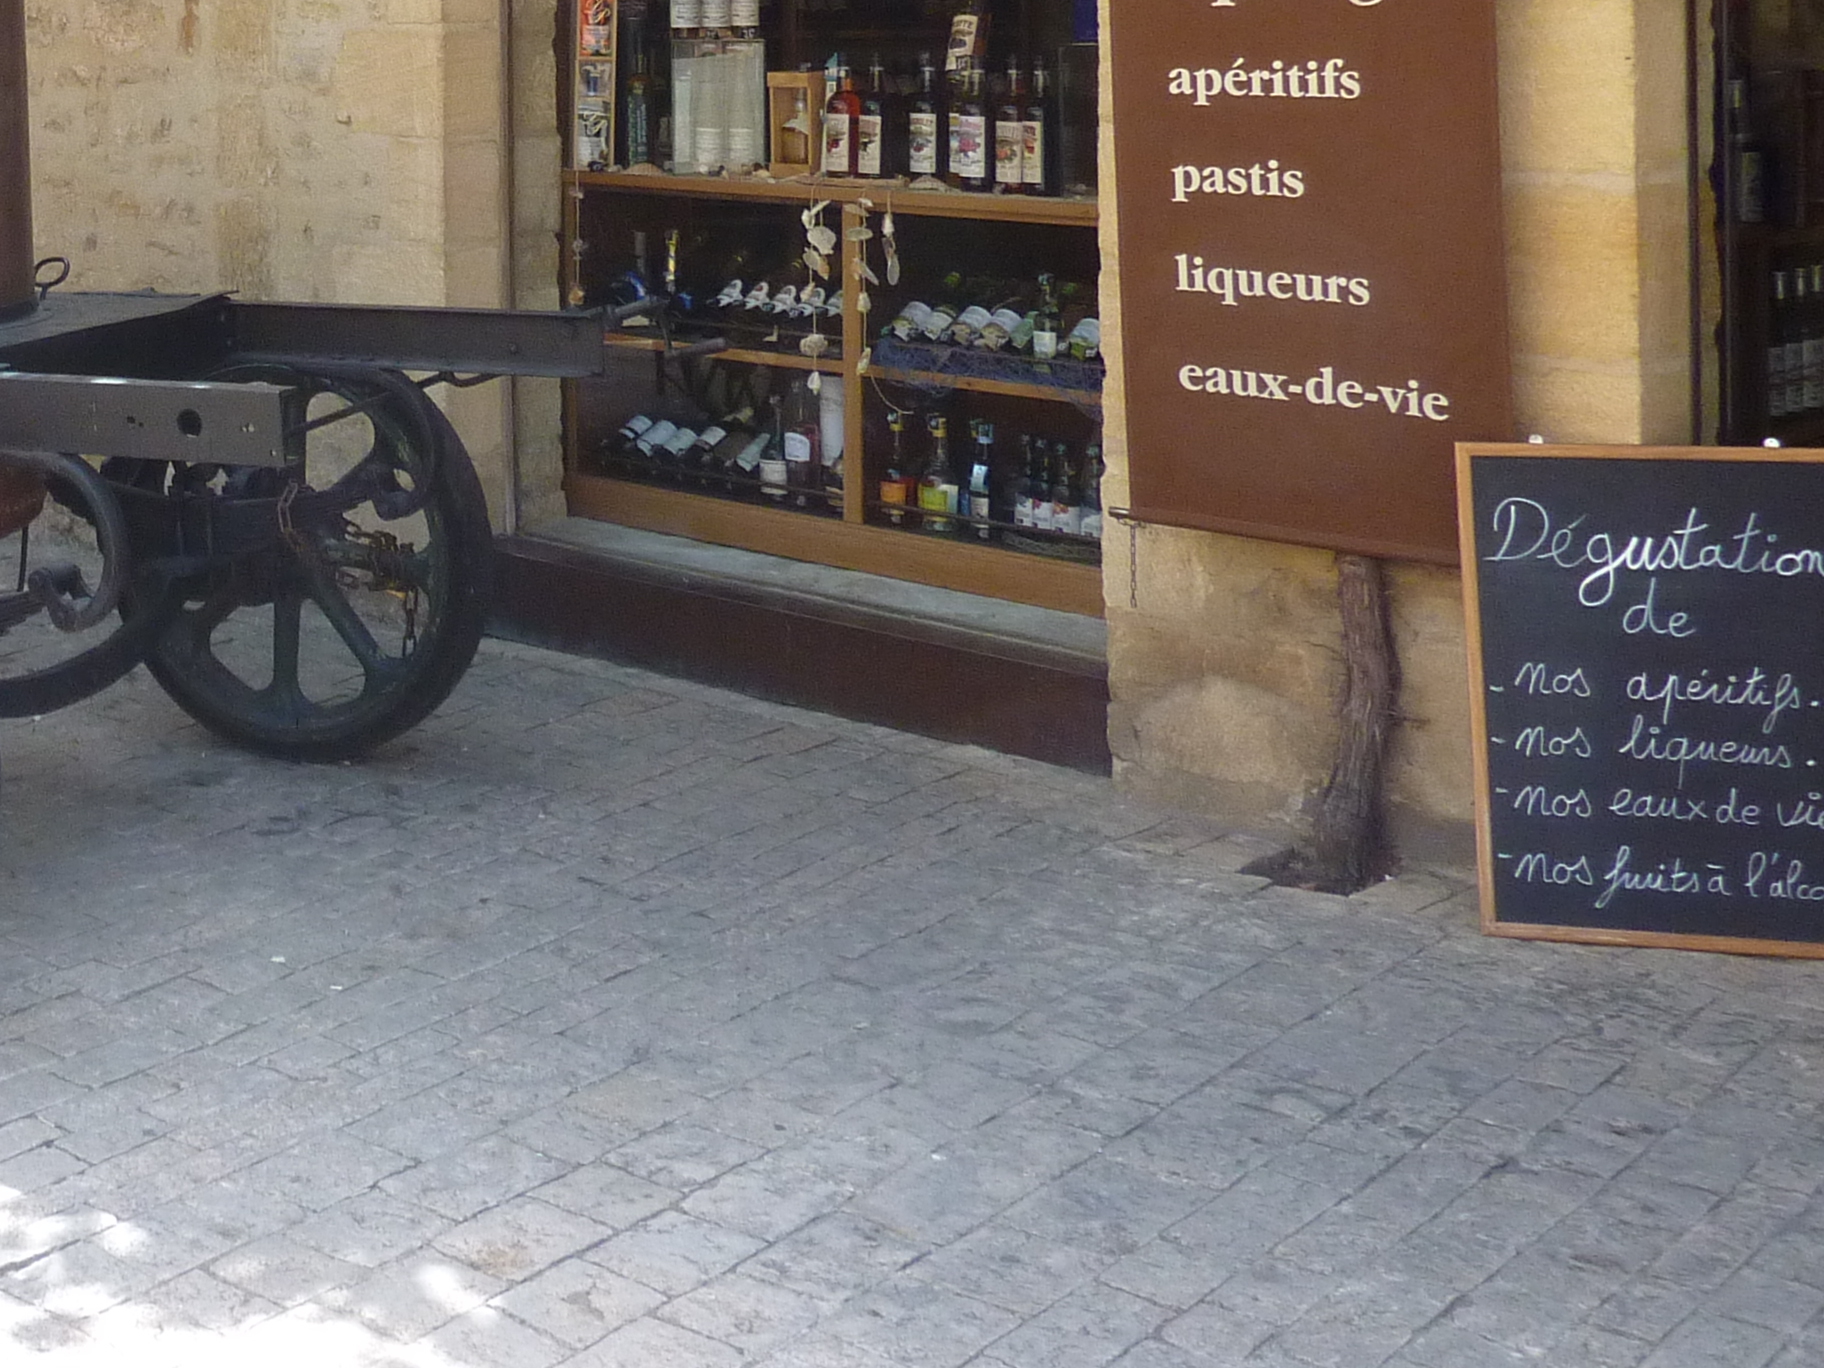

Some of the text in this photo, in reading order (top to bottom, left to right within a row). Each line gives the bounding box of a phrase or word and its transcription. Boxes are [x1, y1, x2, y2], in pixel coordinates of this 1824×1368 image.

[1167, 57, 1362, 106] apéritifs
[1171, 158, 1306, 203] pastis
[1174, 253, 1372, 307] liqueurs
[1177, 362, 1451, 422] eaux-de-vie
[1482, 496, 1824, 608] Dégustation
[1622, 577, 1697, 638] de
[1608, 787, 1709, 821] eaux
[1715, 787, 1761, 825] de
[1594, 845, 1700, 909] fruits
